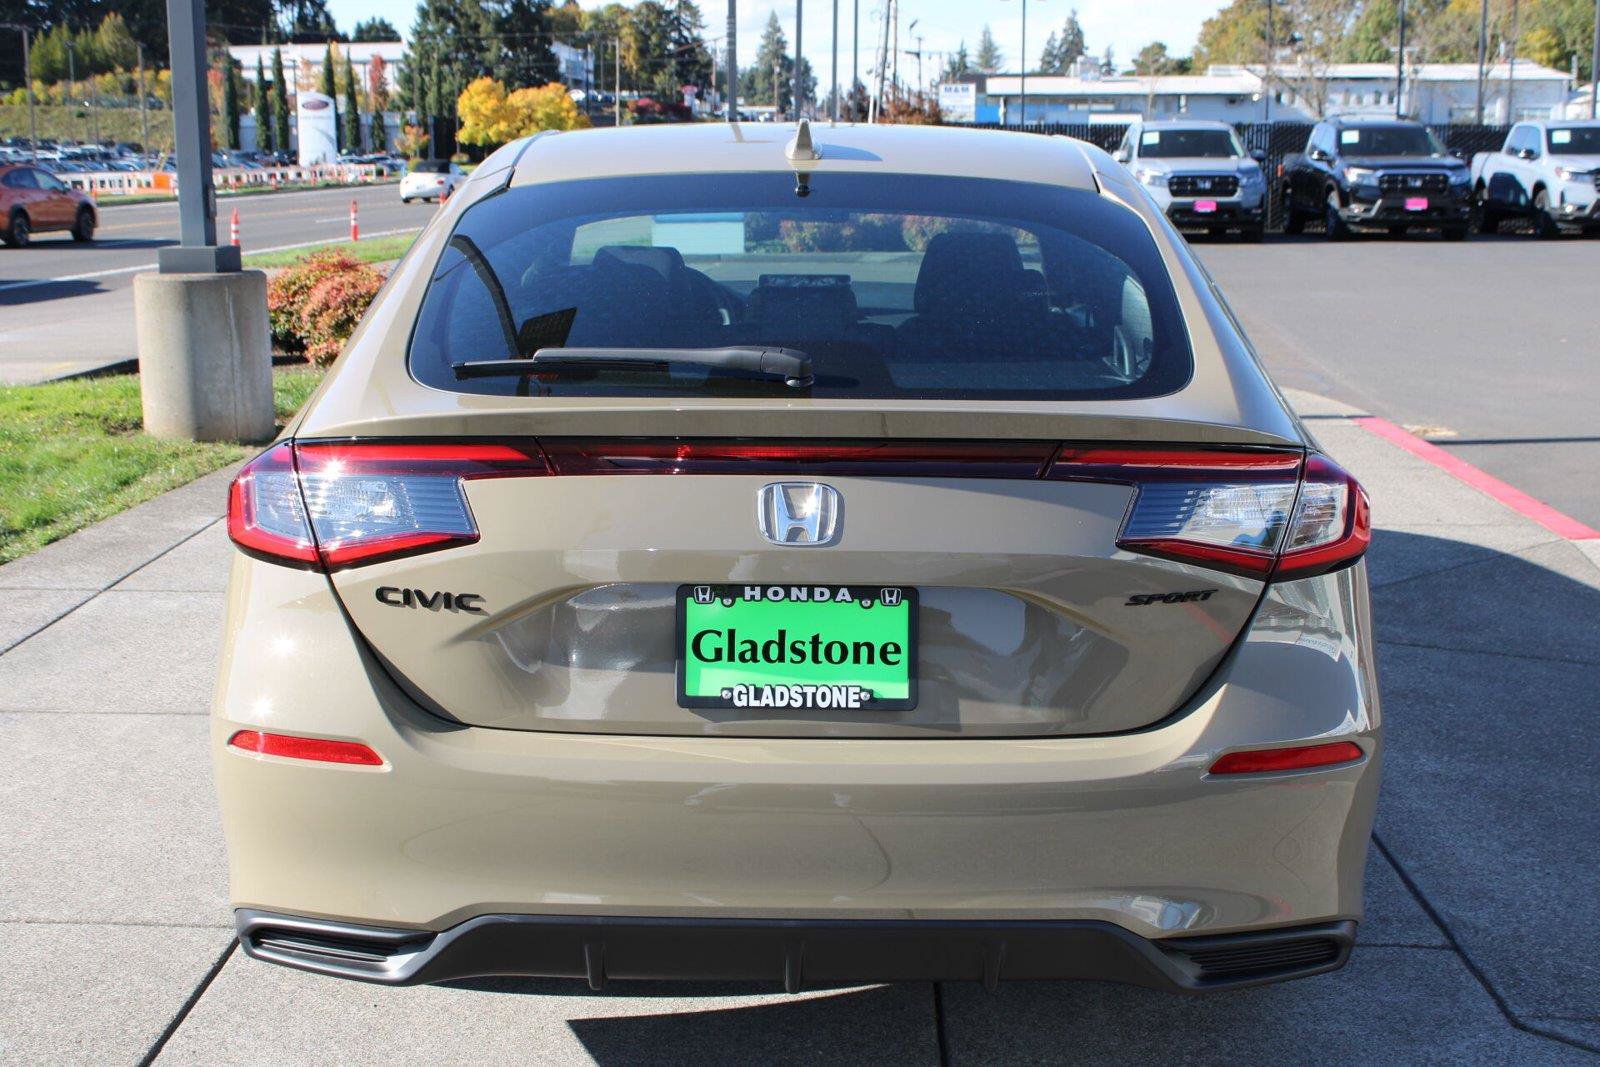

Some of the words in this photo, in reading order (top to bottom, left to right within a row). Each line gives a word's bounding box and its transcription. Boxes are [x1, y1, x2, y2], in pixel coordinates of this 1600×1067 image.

[375, 586, 483, 613] CIVIC
[744, 586, 853, 602] HONDA
[1124, 588, 1219, 606] SPORT
[691, 628, 902, 666] Gladstone
[732, 684, 861, 709] GLADSTONE
